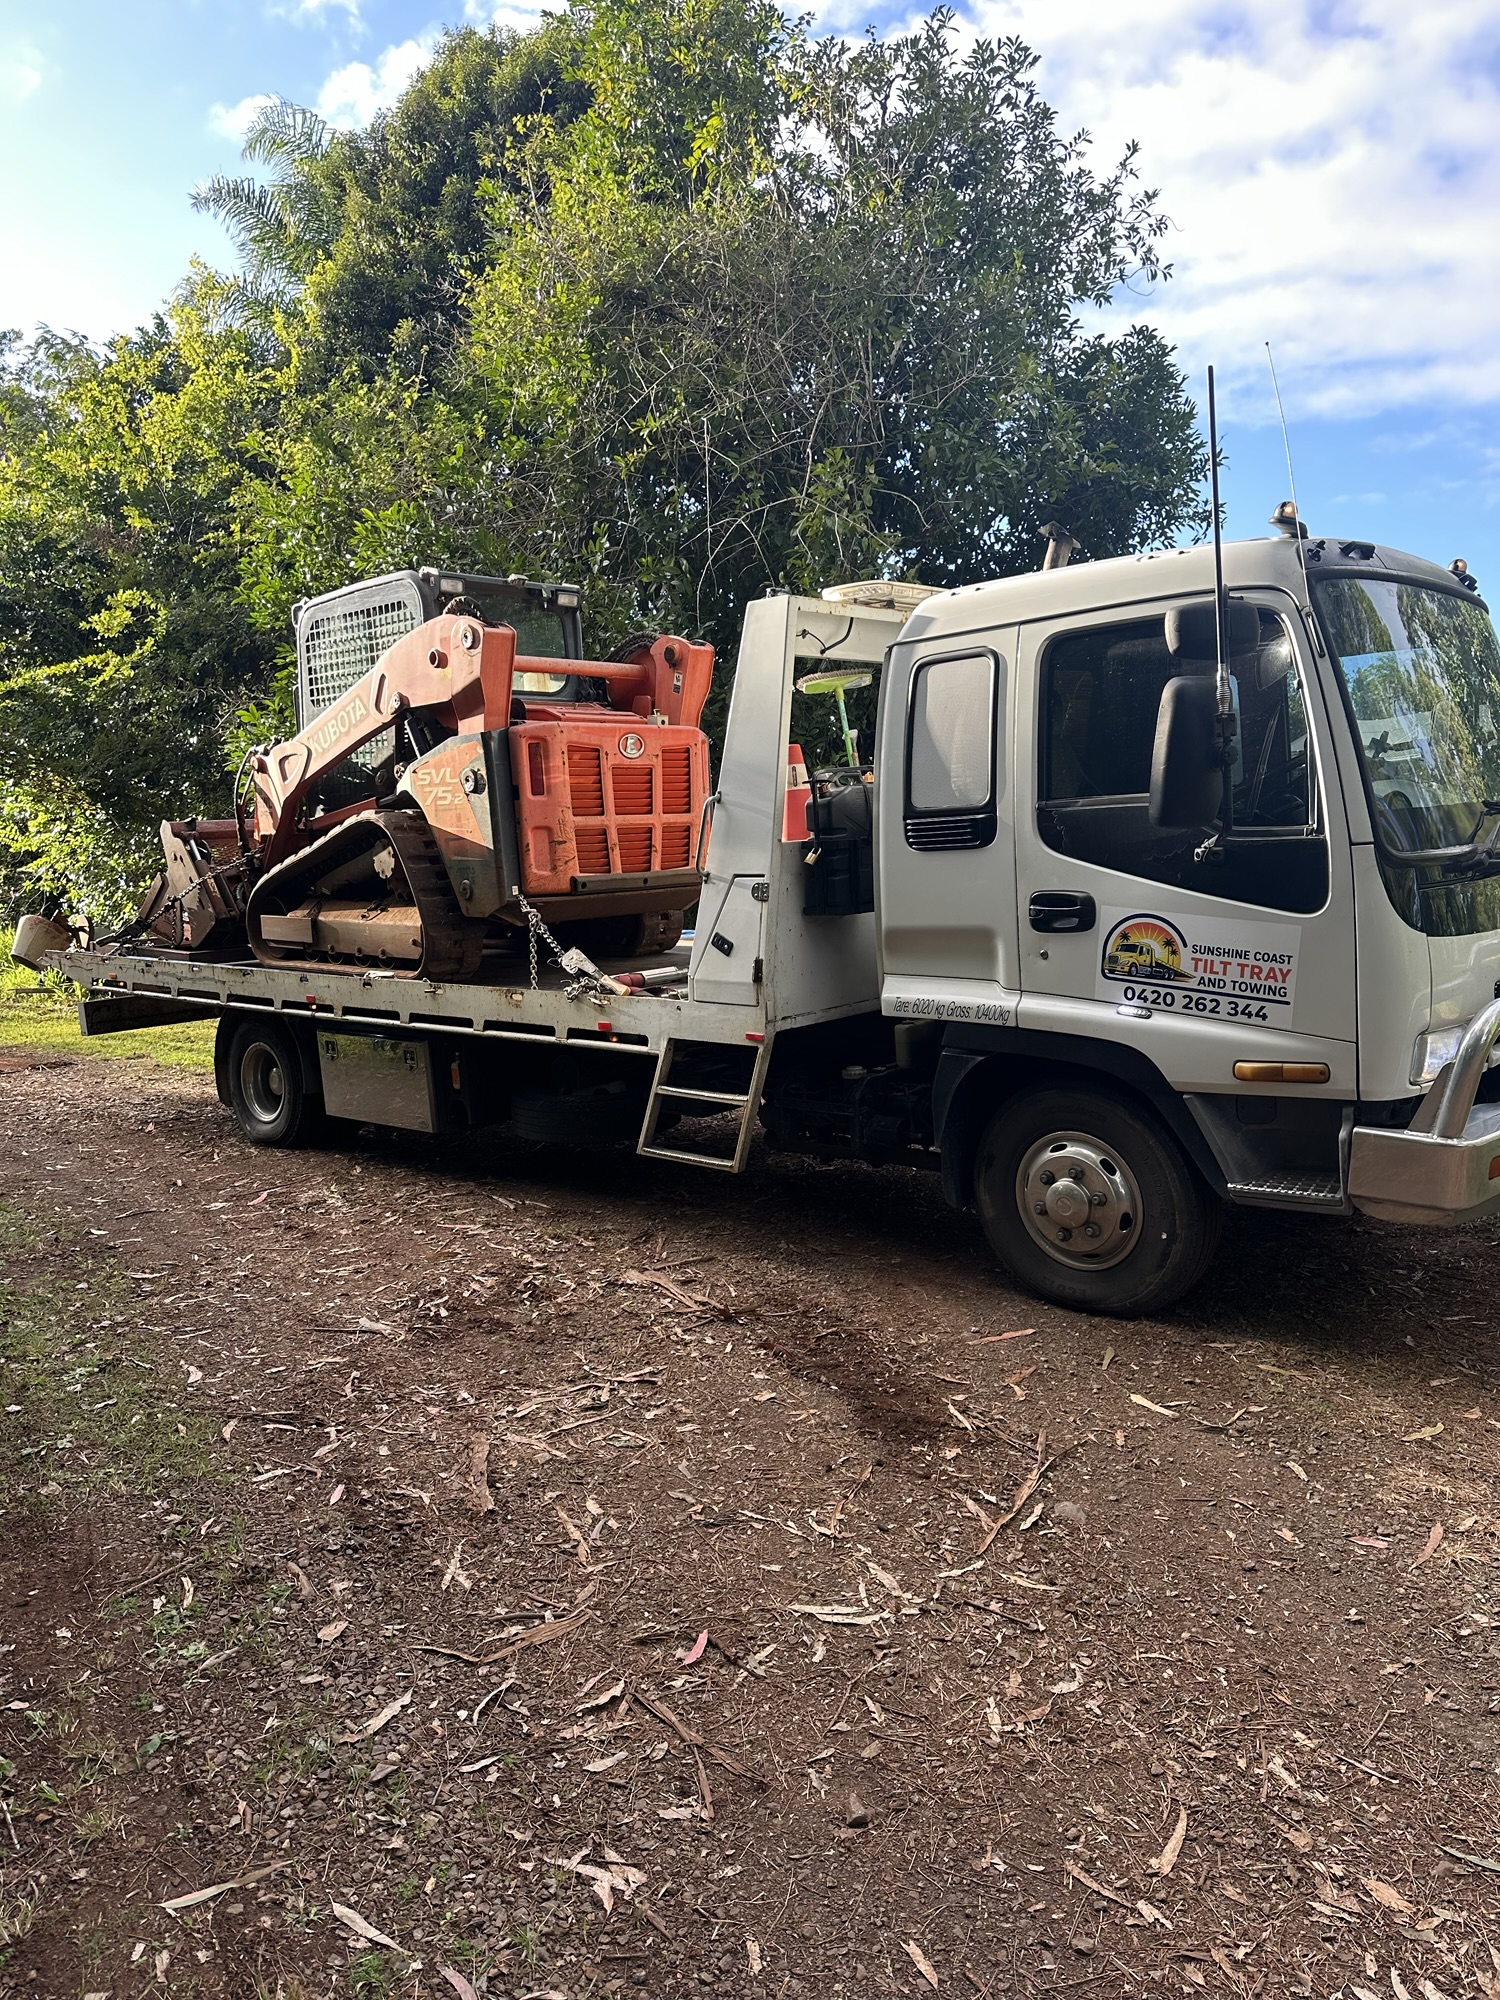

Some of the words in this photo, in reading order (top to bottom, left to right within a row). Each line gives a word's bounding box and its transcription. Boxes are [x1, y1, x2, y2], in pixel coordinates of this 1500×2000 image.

[309, 697, 367, 758] KUBOTA
[417, 767, 459, 785] SVL
[1192, 944, 1250, 960] SUNSHINE
[1253, 951, 1293, 965] COAST
[1191, 957, 1232, 977] TILT
[1237, 963, 1292, 984] TRAY
[1197, 976, 1226, 989] AND
[1230, 980, 1287, 998] TOWING
[893, 997, 911, 1012] Tare:
[912, 998, 934, 1015] 6020
[935, 1002, 945, 1019] kg
[947, 1001, 972, 1019] Gross:
[975, 1003, 1010, 1025] 10400kg
[1123, 986, 1176, 1007] 0420
[1181, 994, 1221, 1015] 262
[1226, 1001, 1268, 1021] 344
